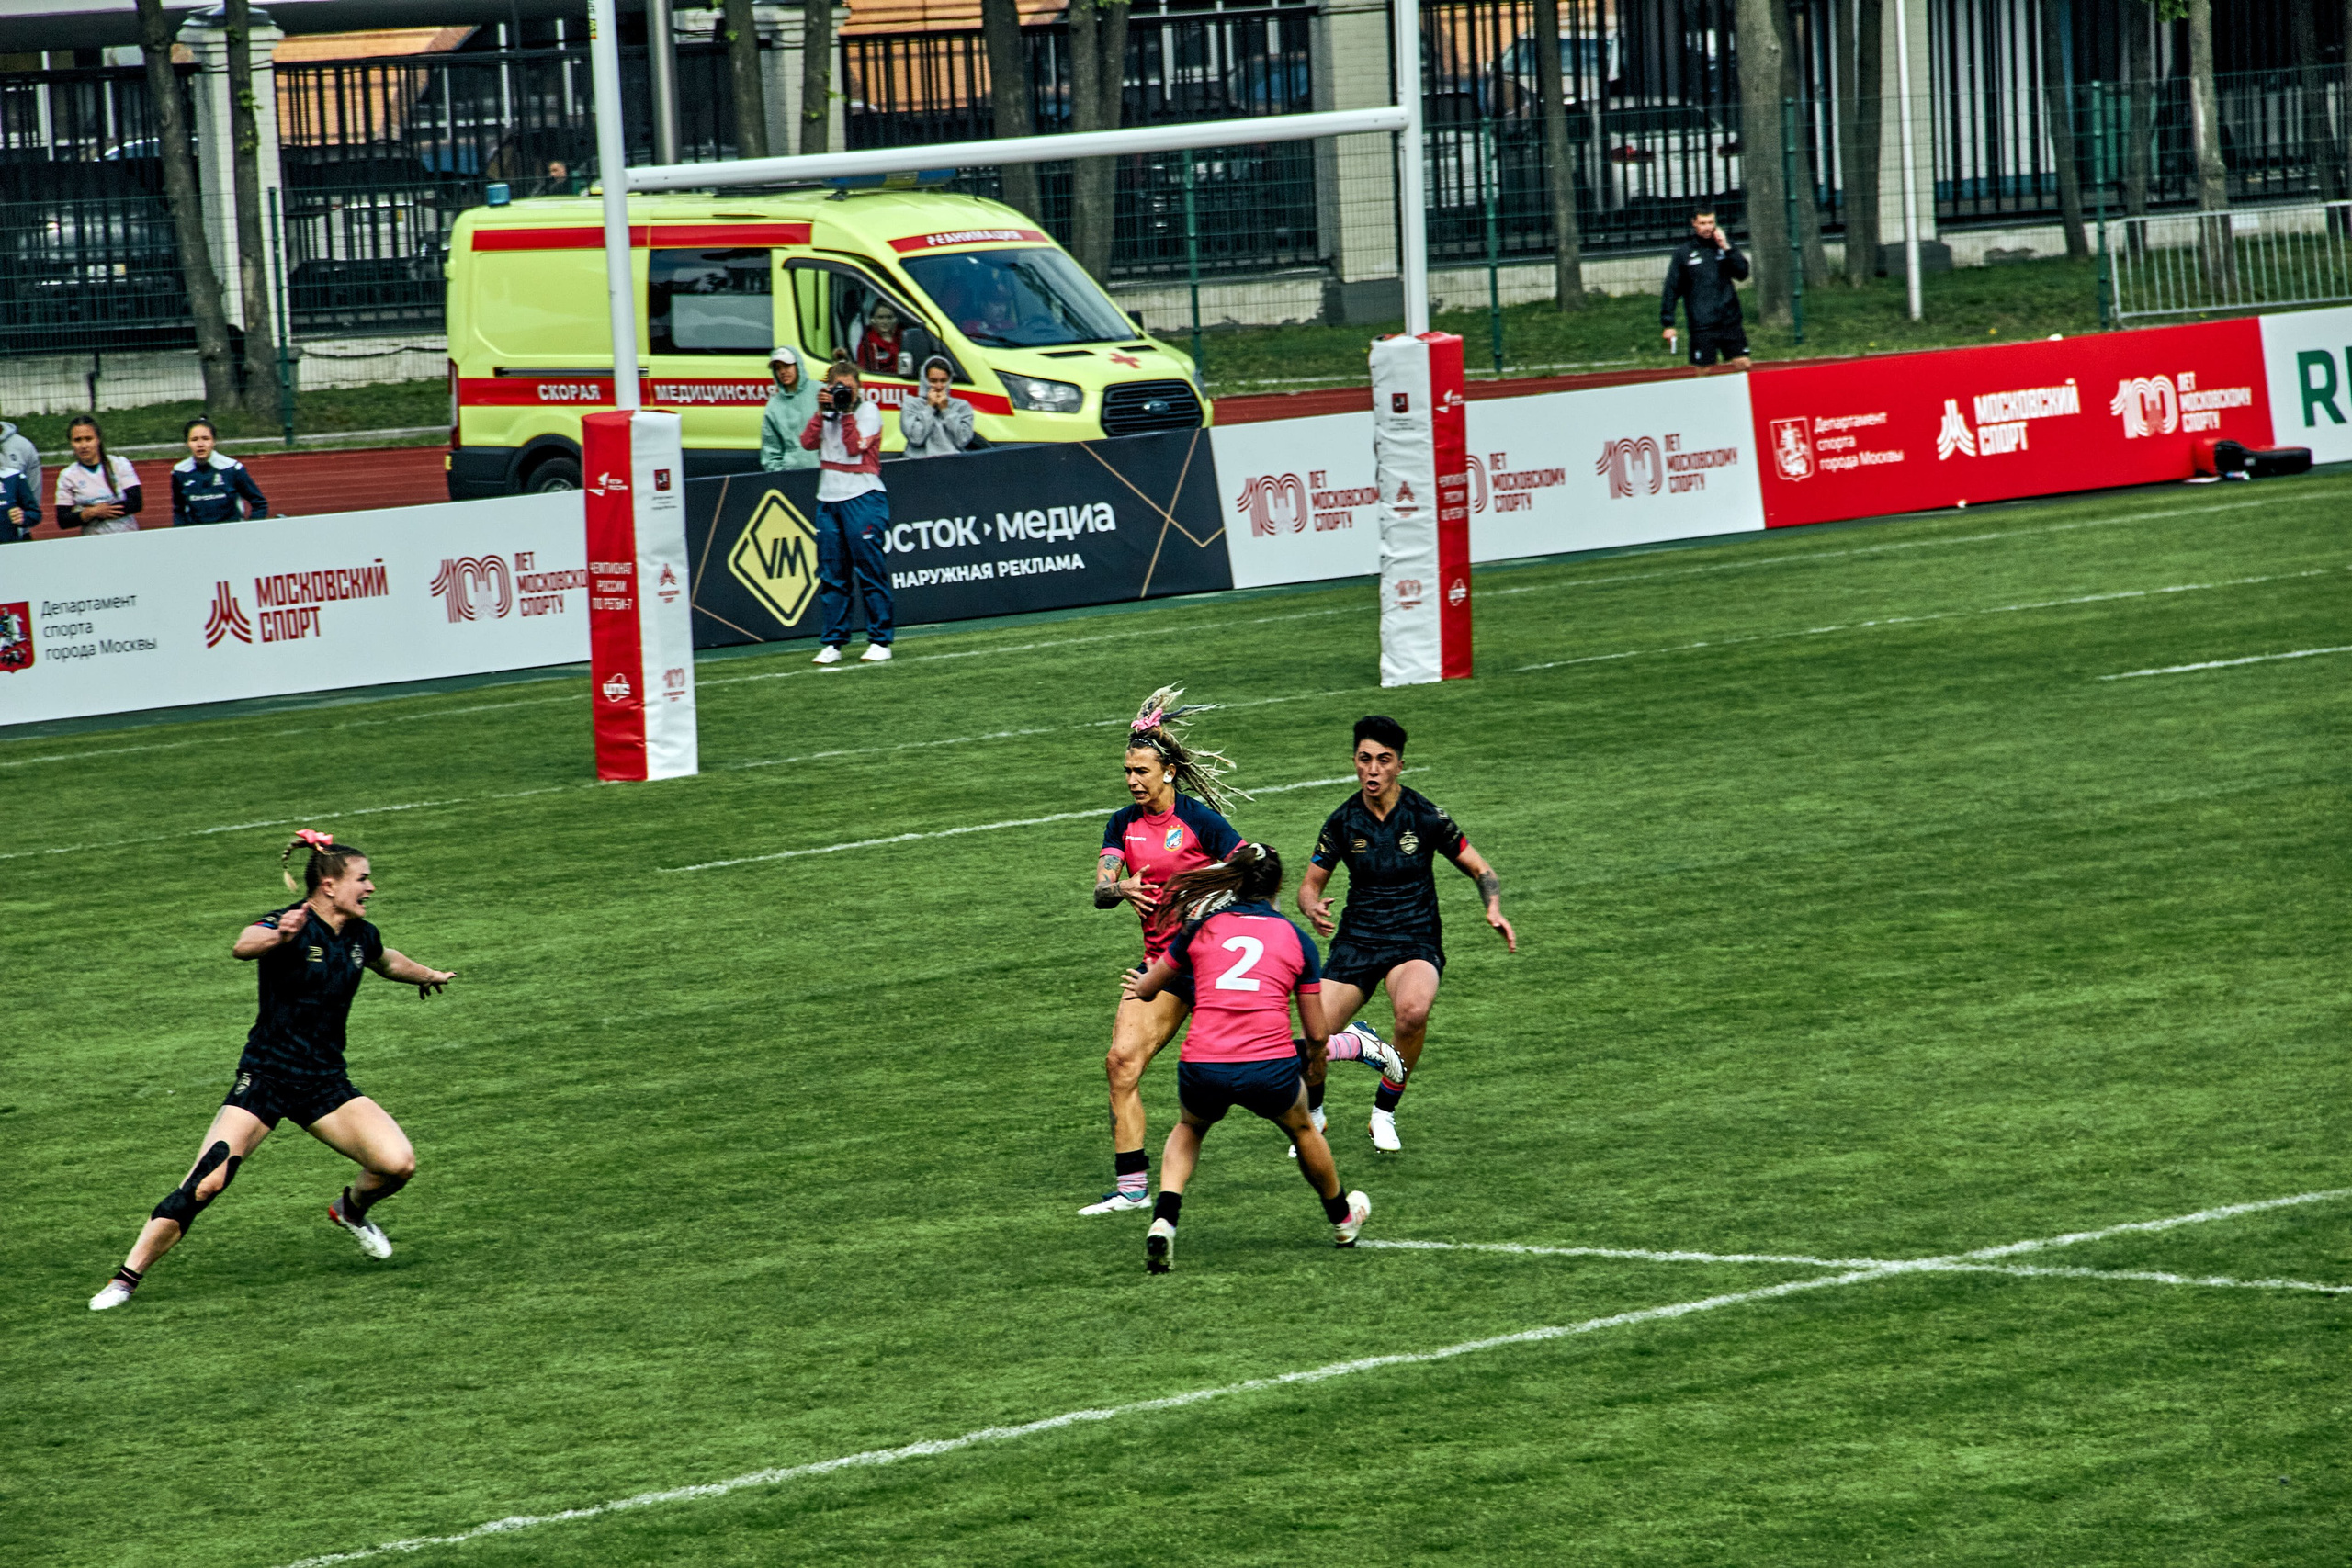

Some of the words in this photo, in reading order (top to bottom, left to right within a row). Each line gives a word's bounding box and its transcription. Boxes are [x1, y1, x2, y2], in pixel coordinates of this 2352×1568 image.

[926, 230, 1023, 246] РЕАНИМАЦИЯ
[537, 384, 602, 400] СКОРАЯ
[2296, 346, 2352, 427] R
[1973, 378, 2081, 425] МОСКОВСКИЙ
[2179, 387, 2252, 412] МОСКОВСКОМУ
[1814, 412, 1887, 434] Департамент
[1978, 421, 2028, 456] СПОРТ
[1666, 447, 1738, 473] МОСКОВСКОМУ
[1491, 468, 1566, 491] МОСКОВСКОМУ
[1668, 473, 1705, 493] СПОРТУ
[1494, 491, 1532, 513] СПОРТУ
[1314, 511, 1352, 532] СПОРТУ
[254, 558, 389, 608] МОСКОВСКИЙ
[892, 562, 995, 590] НАРУЖНАЯ
[997, 553, 1086, 578] РЕКЛАМА
[430, 555, 513, 623] 100
[40, 595, 137, 618] Департамент
[519, 594, 564, 616] СПОРТУ
[43, 621, 94, 639] спорта
[259, 605, 321, 643] СПОРТ
[46, 643, 96, 662] города
[99, 638, 158, 655] Москвы
[1215, 935, 1264, 992] 2
